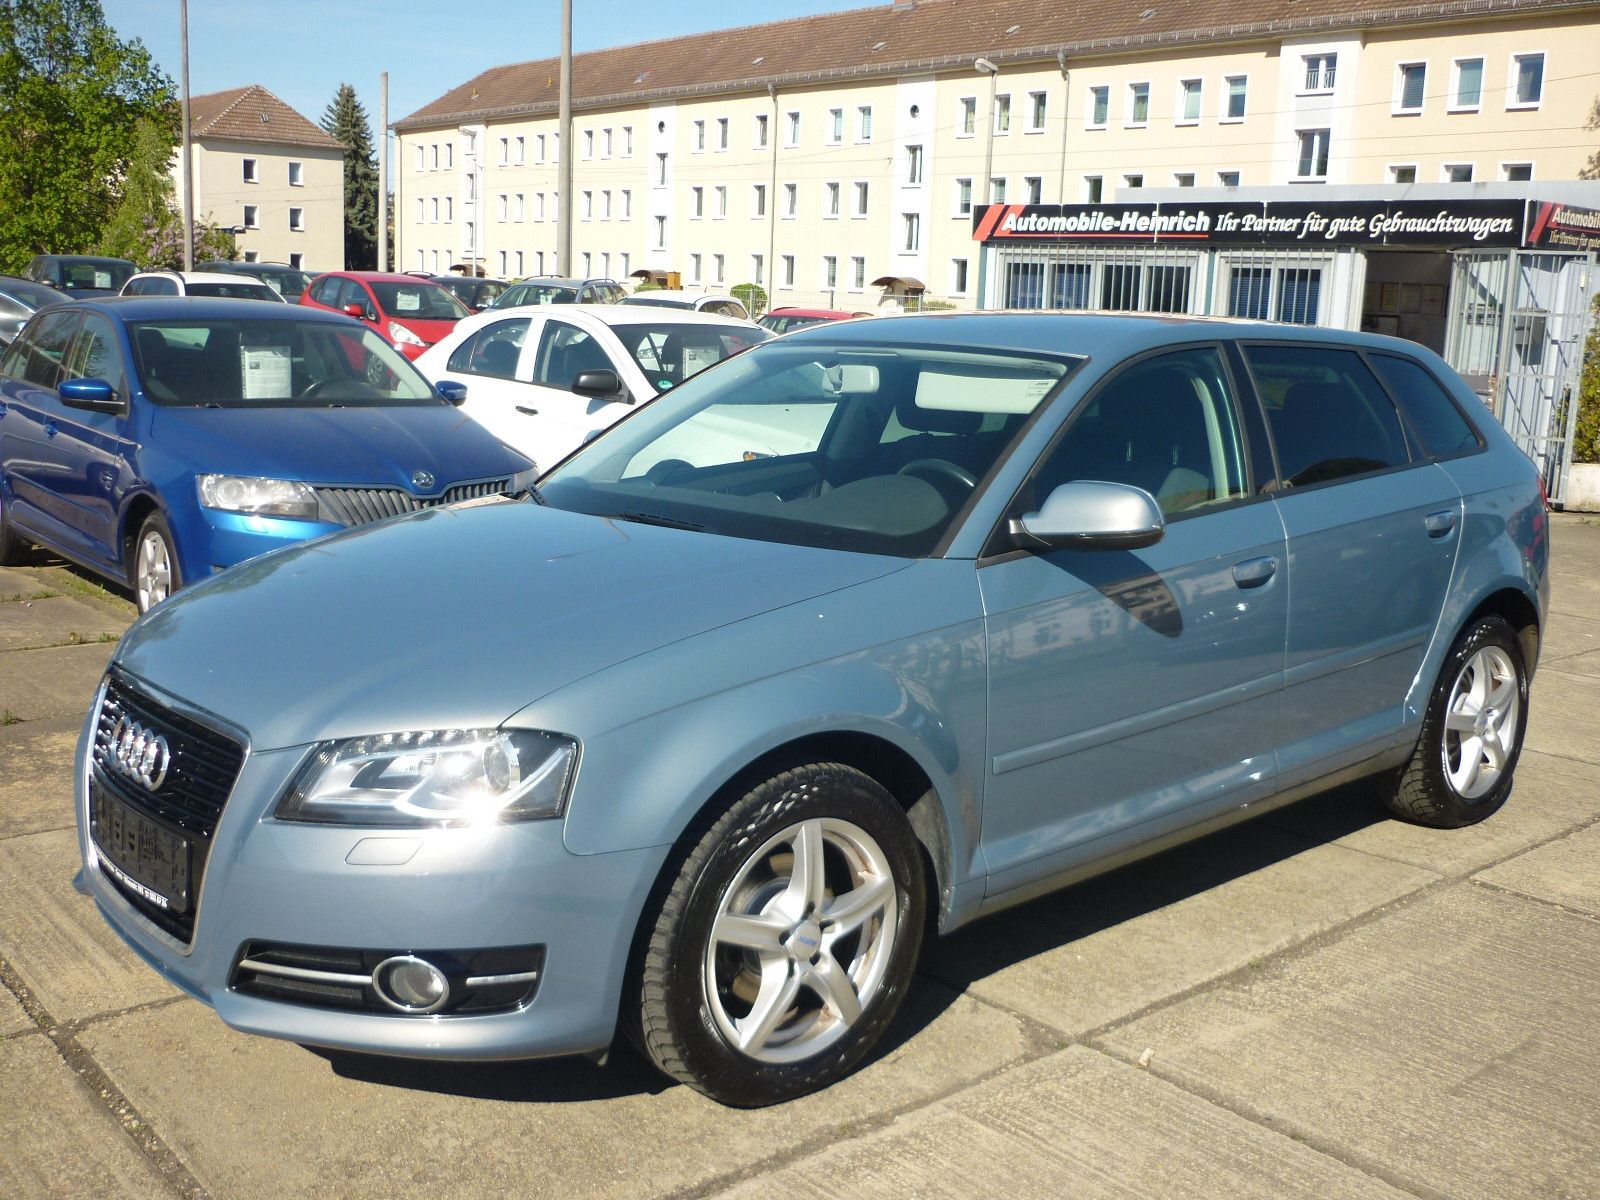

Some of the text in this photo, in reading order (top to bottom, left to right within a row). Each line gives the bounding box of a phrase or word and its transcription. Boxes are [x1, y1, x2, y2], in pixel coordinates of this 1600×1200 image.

[1002, 210, 1513, 240] Automobile-Heinrich Ihr Partner für gute Gebrauchtwagen
[1552, 207, 1600, 228] Automobil
